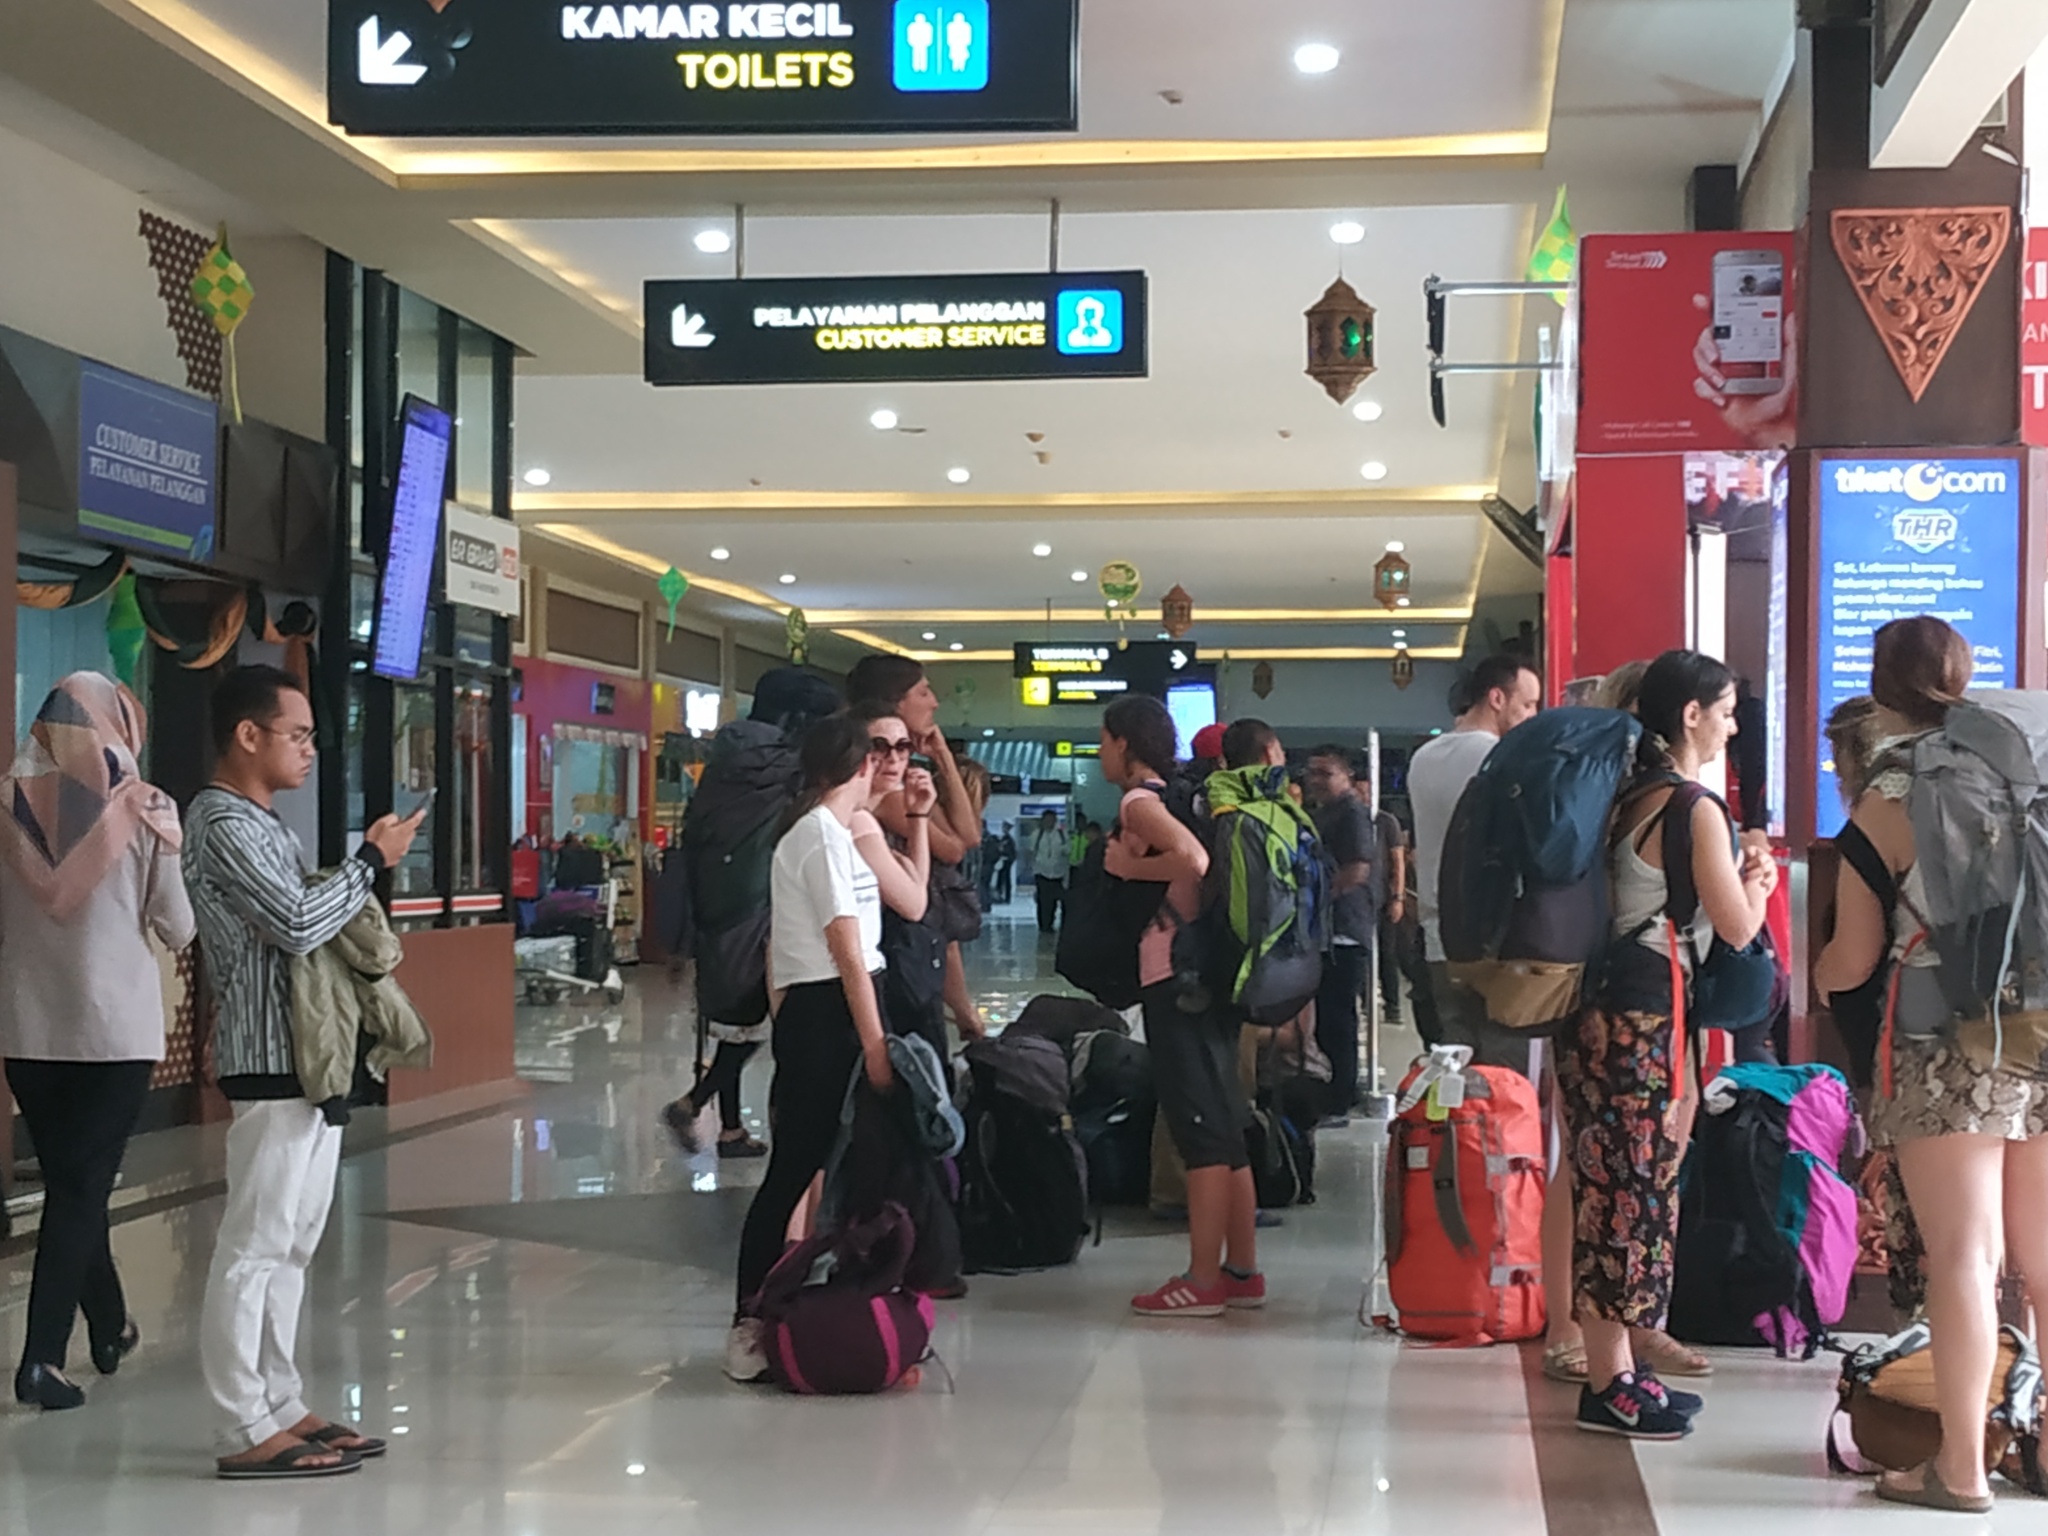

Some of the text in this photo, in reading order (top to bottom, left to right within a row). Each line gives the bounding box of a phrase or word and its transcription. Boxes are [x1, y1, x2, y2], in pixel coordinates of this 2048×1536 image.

[562, 3, 854, 39] KAMAR KECIL
[676, 52, 855, 89] TOILETS
[754, 302, 1046, 327] PELAYANAN PELANGGAN
[816, 324, 1046, 350] CUSTOMER SERVICE
[95, 422, 202, 476] CUSTOMER SERVICE
